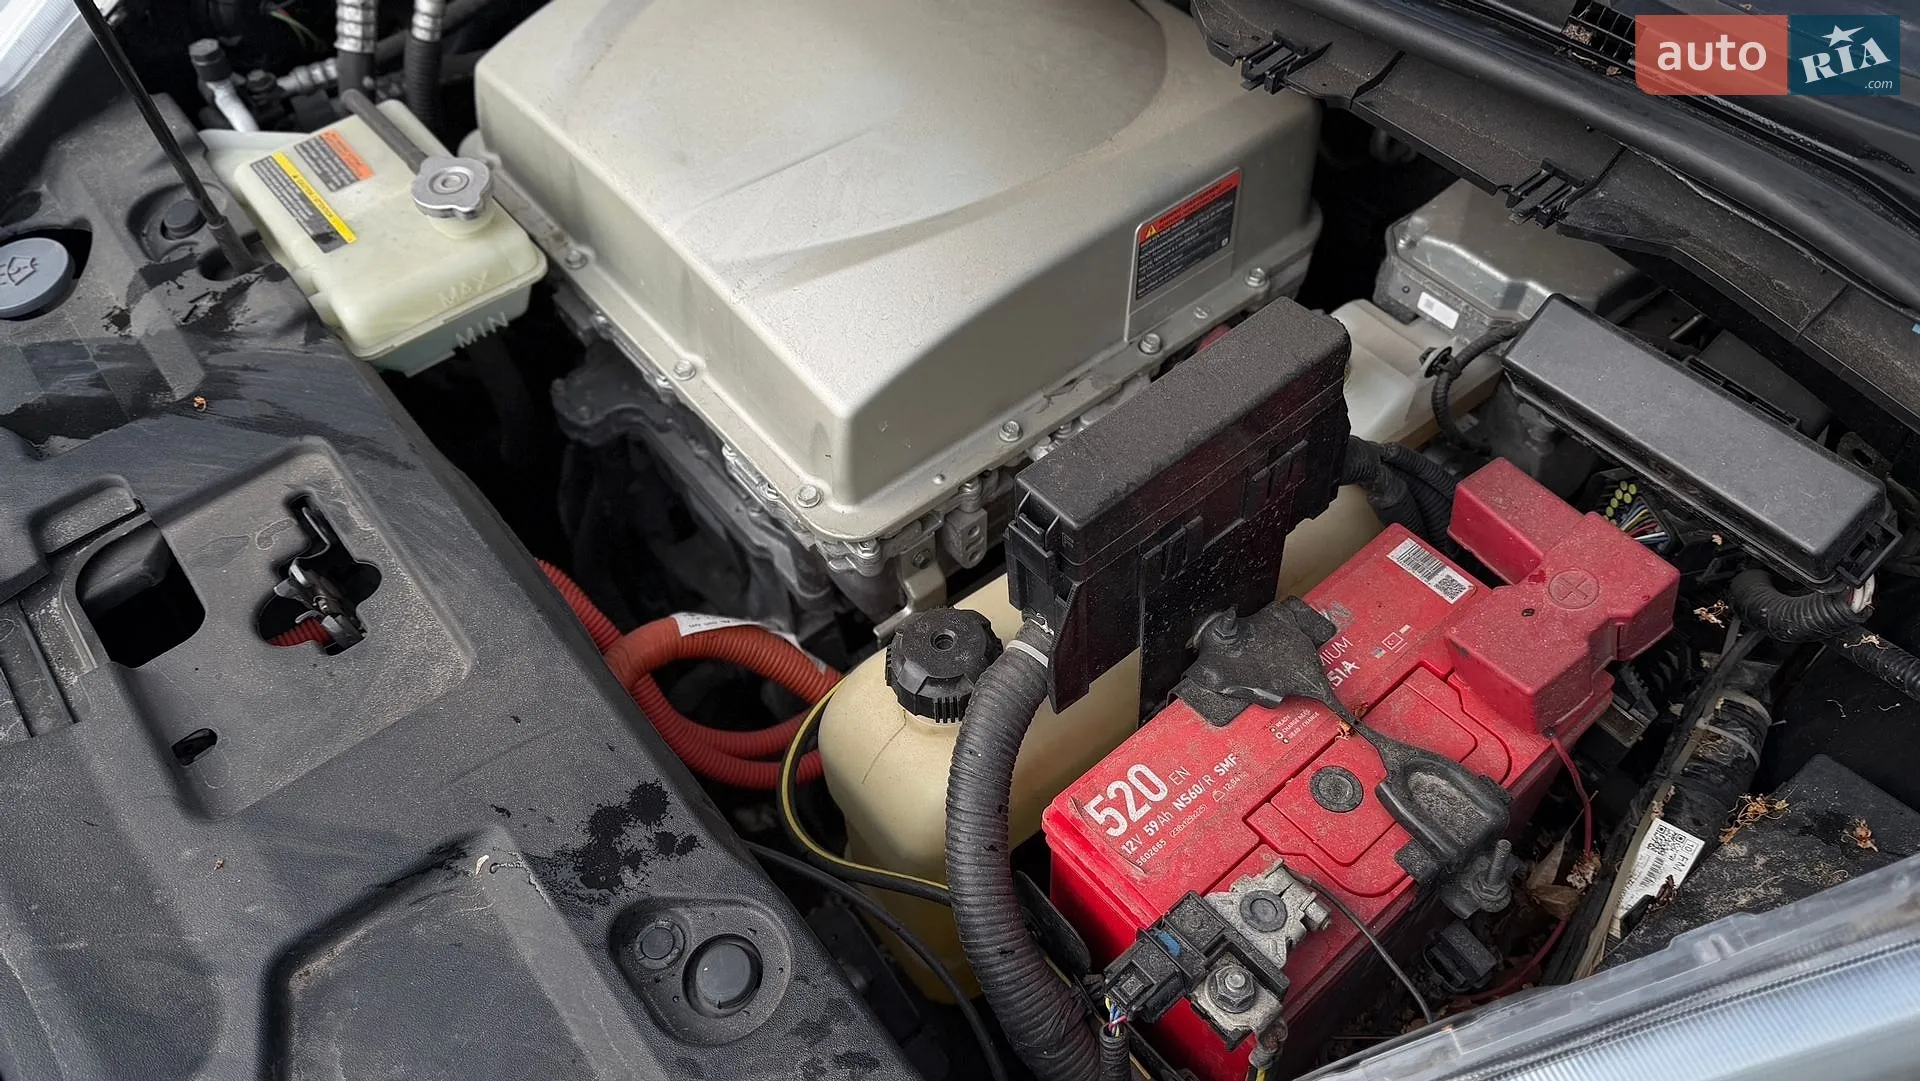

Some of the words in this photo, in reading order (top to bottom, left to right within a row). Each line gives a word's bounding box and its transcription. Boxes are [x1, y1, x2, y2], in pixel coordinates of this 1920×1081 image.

[438, 269, 489, 308] MAX
[455, 311, 508, 348] MIN
[1083, 763, 1168, 837] 520
[1168, 765, 1191, 786] EN
[1121, 833, 1143, 855] 12V
[1214, 753, 1237, 776] SMF
